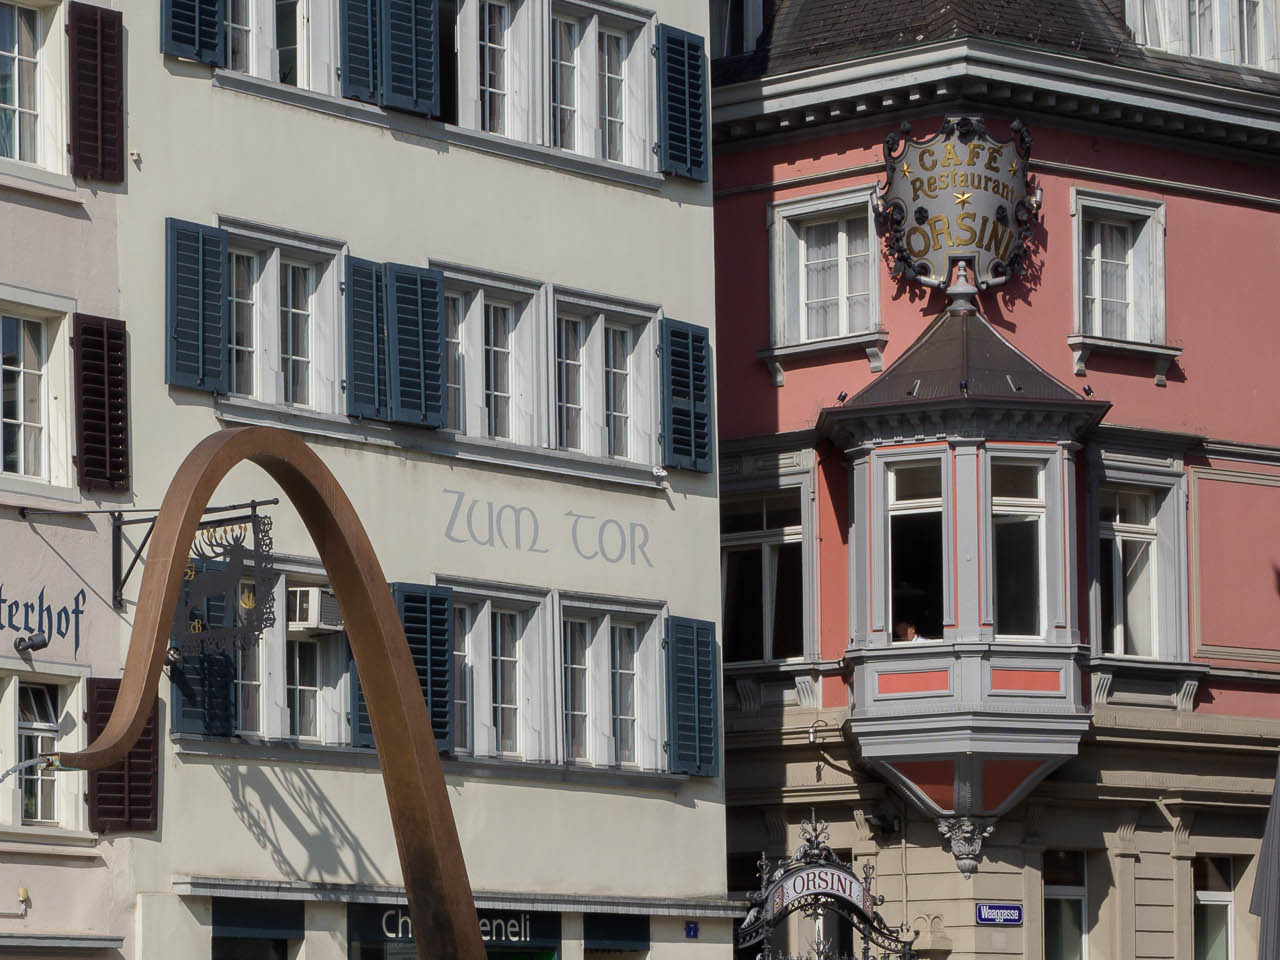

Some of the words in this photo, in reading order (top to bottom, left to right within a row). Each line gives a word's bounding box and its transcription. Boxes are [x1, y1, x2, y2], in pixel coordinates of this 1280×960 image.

[910, 169, 1015, 204] Restaurant
[906, 212, 1014, 260] ORSINI
[442, 488, 549, 554] ZUM
[564, 510, 654, 567] TOR
[793, 871, 853, 898] ORSINI
[382, 909, 413, 938] Ch
[479, 913, 531, 942] eneli
[980, 905, 1019, 922] Waaggasse
